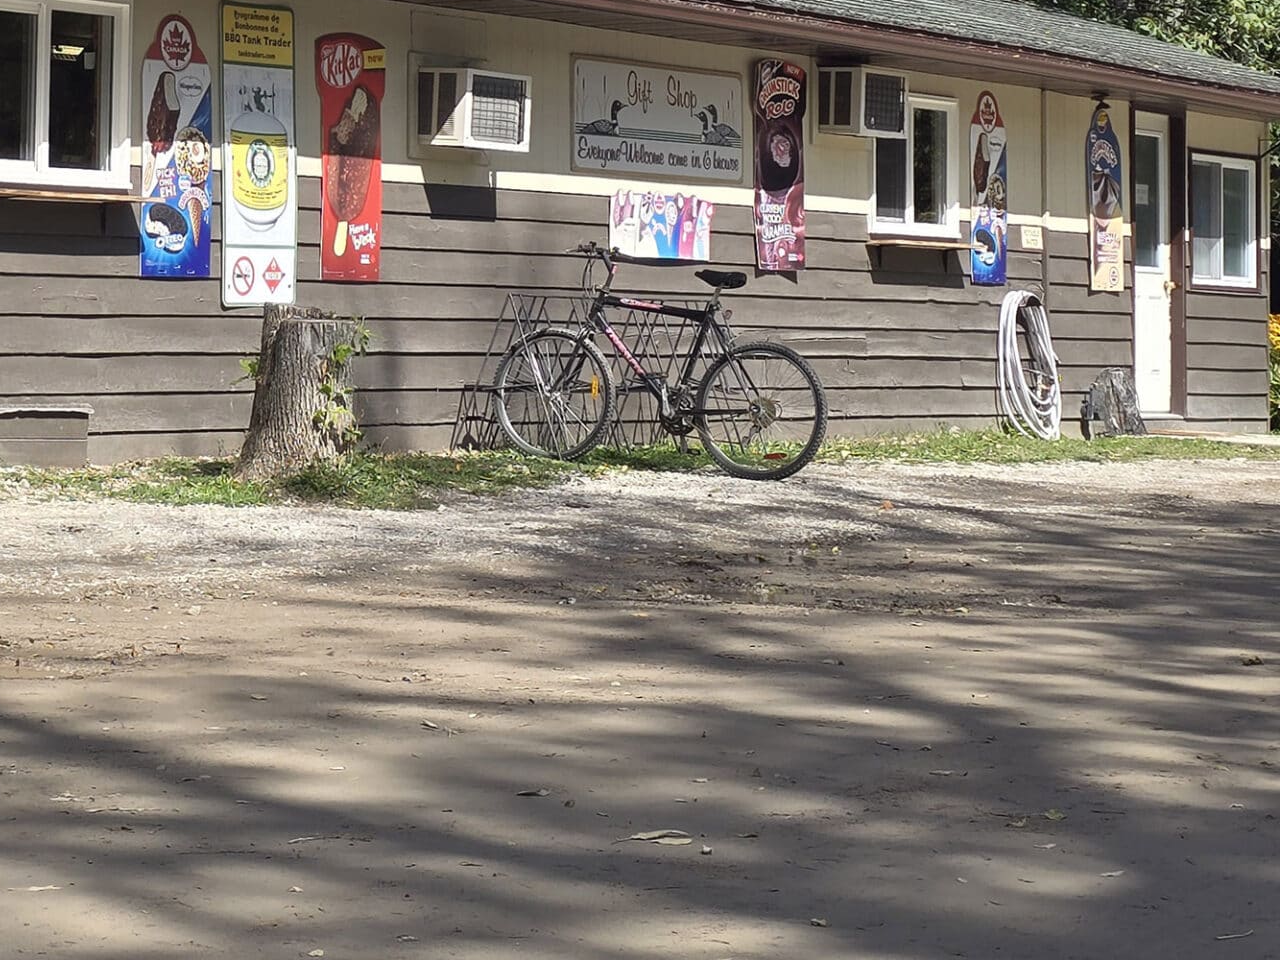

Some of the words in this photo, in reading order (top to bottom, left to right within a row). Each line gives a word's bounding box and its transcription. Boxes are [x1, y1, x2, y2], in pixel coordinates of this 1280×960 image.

[233, 10, 270, 22] Programme
[271, 14, 280, 23] de
[234, 21, 269, 33] Bonbonnes
[270, 25, 279, 33] de
[224, 32, 241, 43] BBQ
[242, 34, 262, 45] Tank
[263, 36, 292, 48] Trader
[327, 44, 361, 86] KitKat
[367, 55, 383, 63] new
[786, 64, 800, 76] NEW
[626, 70, 654, 114] Gift
[666, 74, 698, 115] Shop
[759, 76, 801, 109] DRUMSTICK
[577, 136, 622, 169] Everyone
[620, 140, 665, 168] Welcome
[668, 152, 689, 169] come
[691, 149, 702, 170] in
[712, 155, 740, 172] browse
[156, 167, 176, 178] PICK
[158, 178, 174, 186] ONE
[159, 185, 177, 198] EH!
[761, 223, 797, 240] CARAMEL
